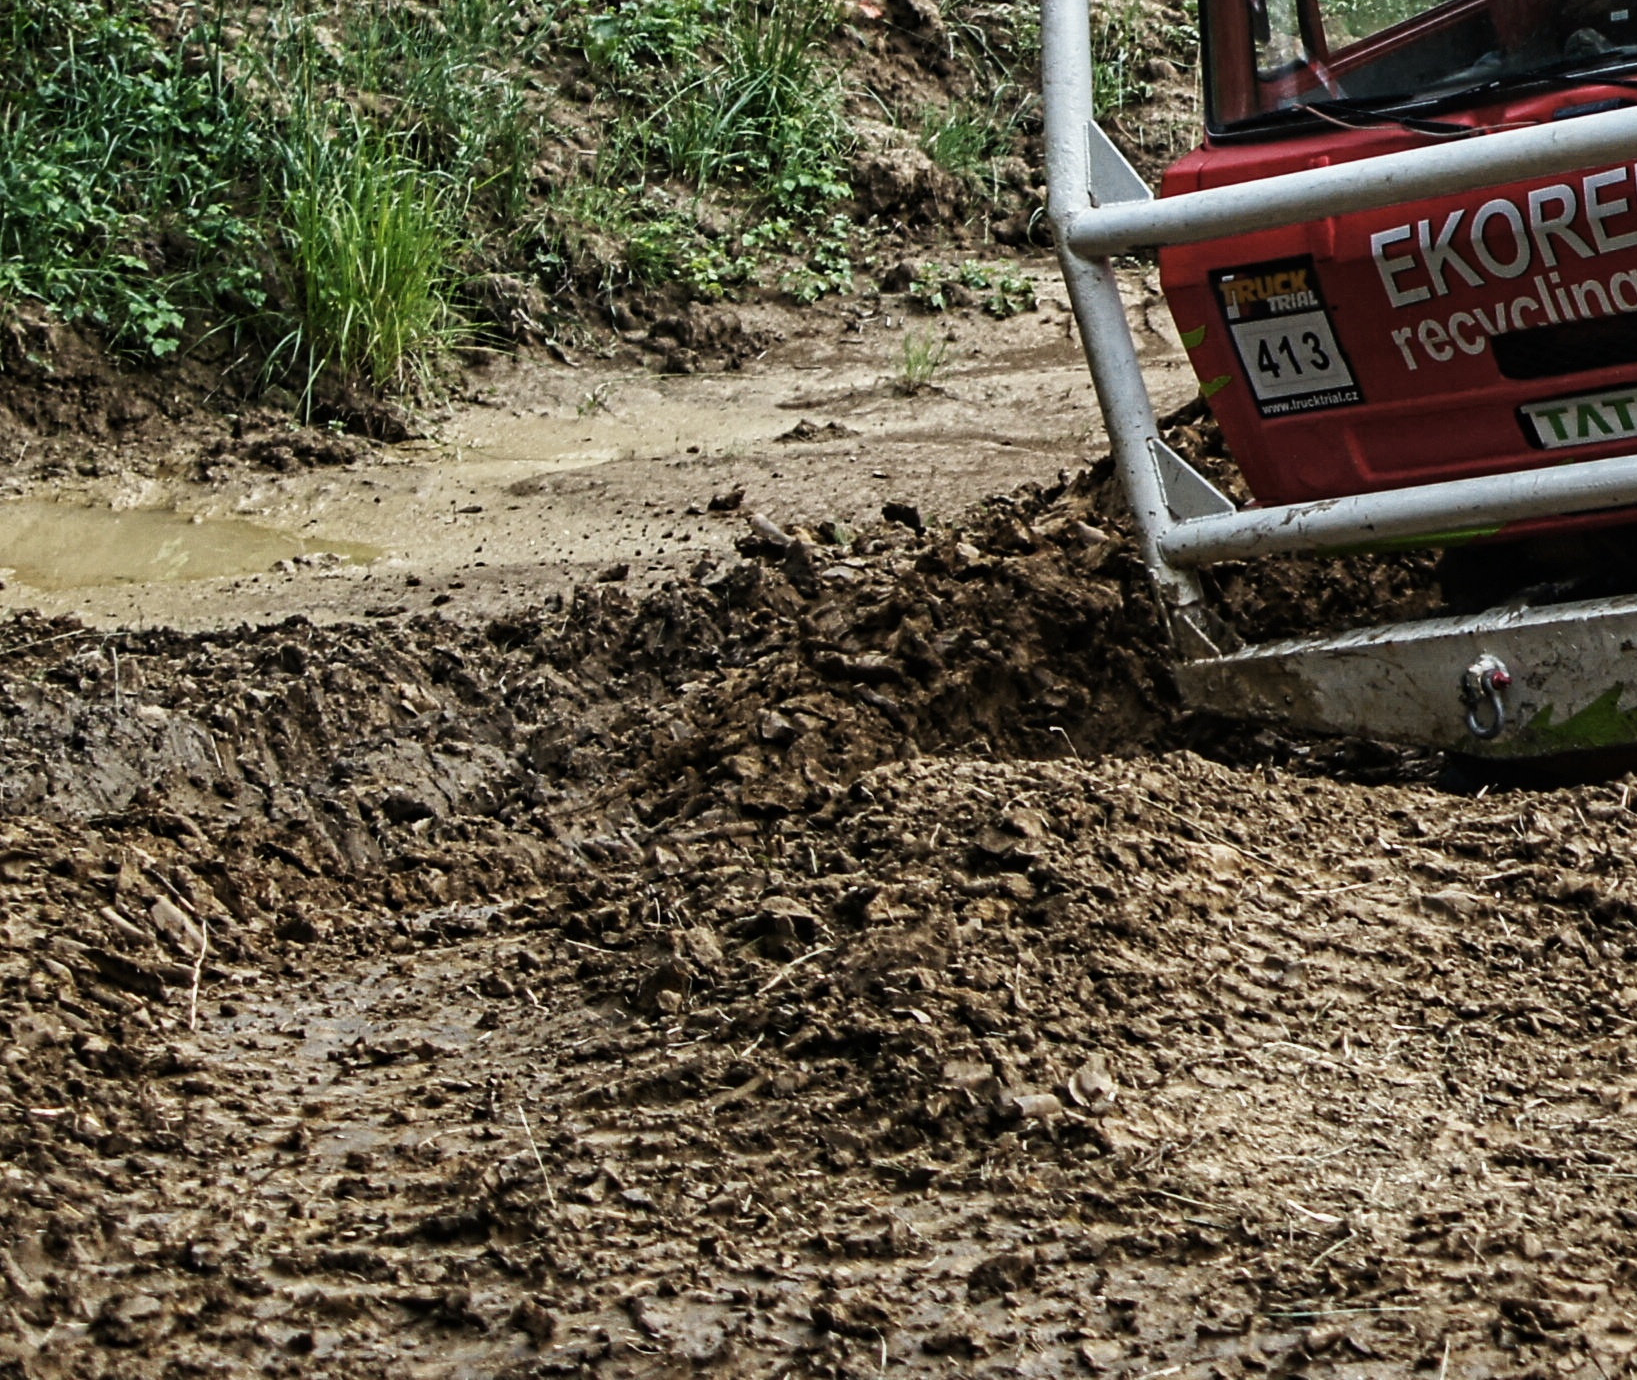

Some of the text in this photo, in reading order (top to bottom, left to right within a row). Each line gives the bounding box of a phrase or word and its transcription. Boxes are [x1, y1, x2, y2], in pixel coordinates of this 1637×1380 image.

[1219, 270, 1309, 307] TRUCK
[1267, 289, 1319, 314] TRIAL
[1257, 331, 1331, 379] 413
[1261, 390, 1360, 415] www.trucktrial.cz
